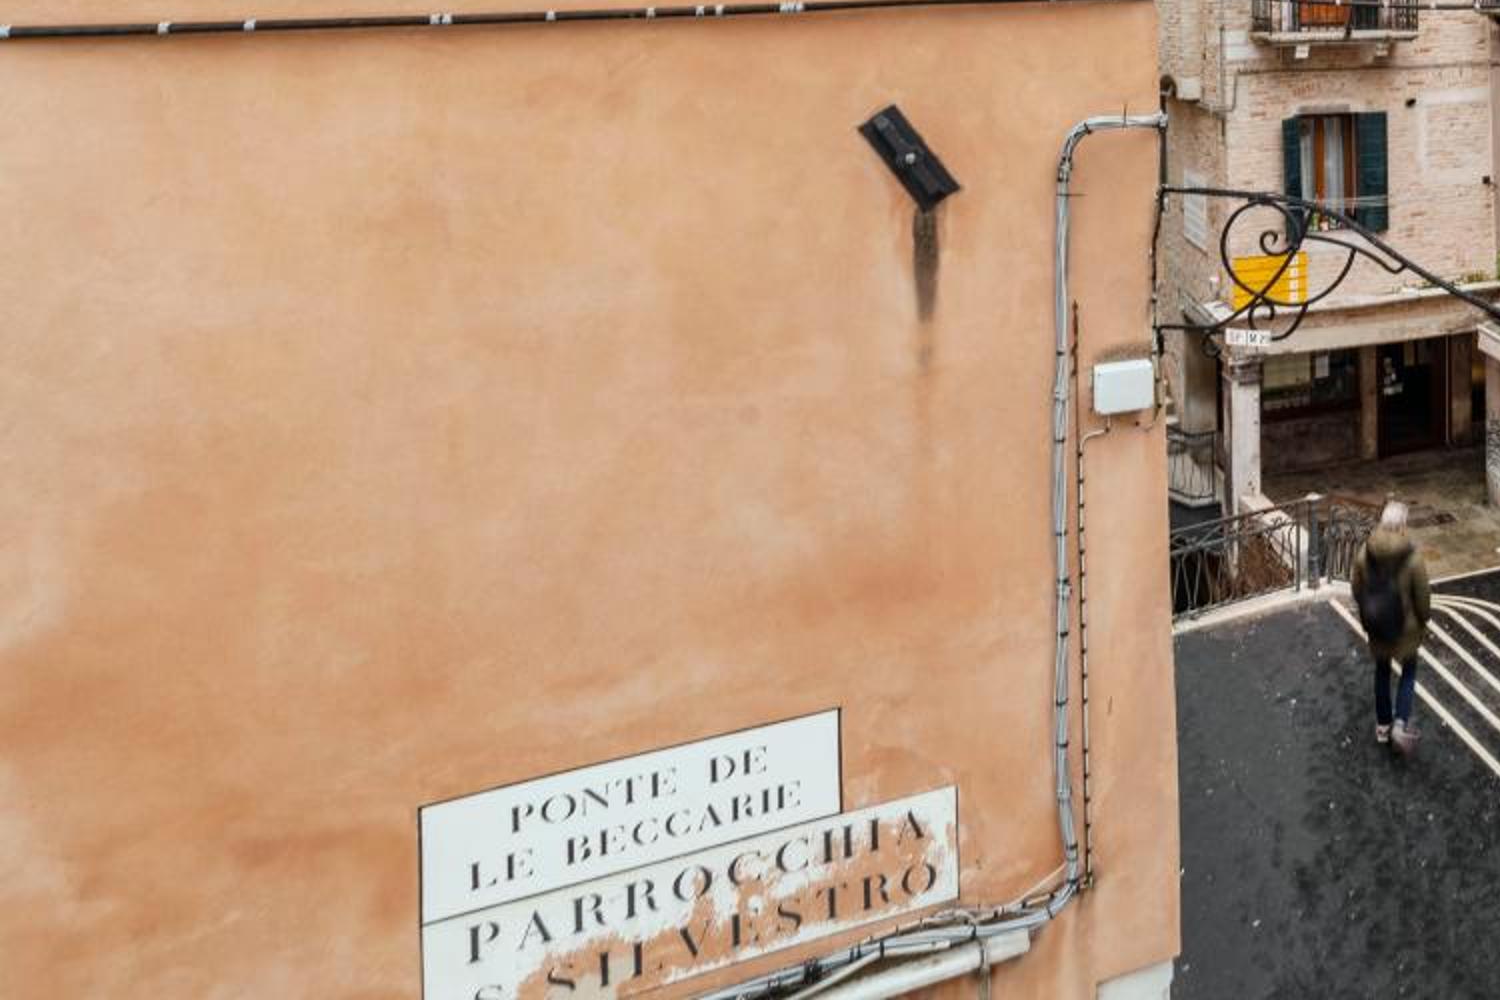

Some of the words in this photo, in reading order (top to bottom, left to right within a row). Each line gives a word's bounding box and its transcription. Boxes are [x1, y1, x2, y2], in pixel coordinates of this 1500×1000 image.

[470, 847, 534, 891] LE
[566, 780, 802, 866] BECCARIE
[510, 767, 677, 833] PONTE
[709, 745, 768, 785] DE
[467, 810, 926, 963] PARROCCHIA
